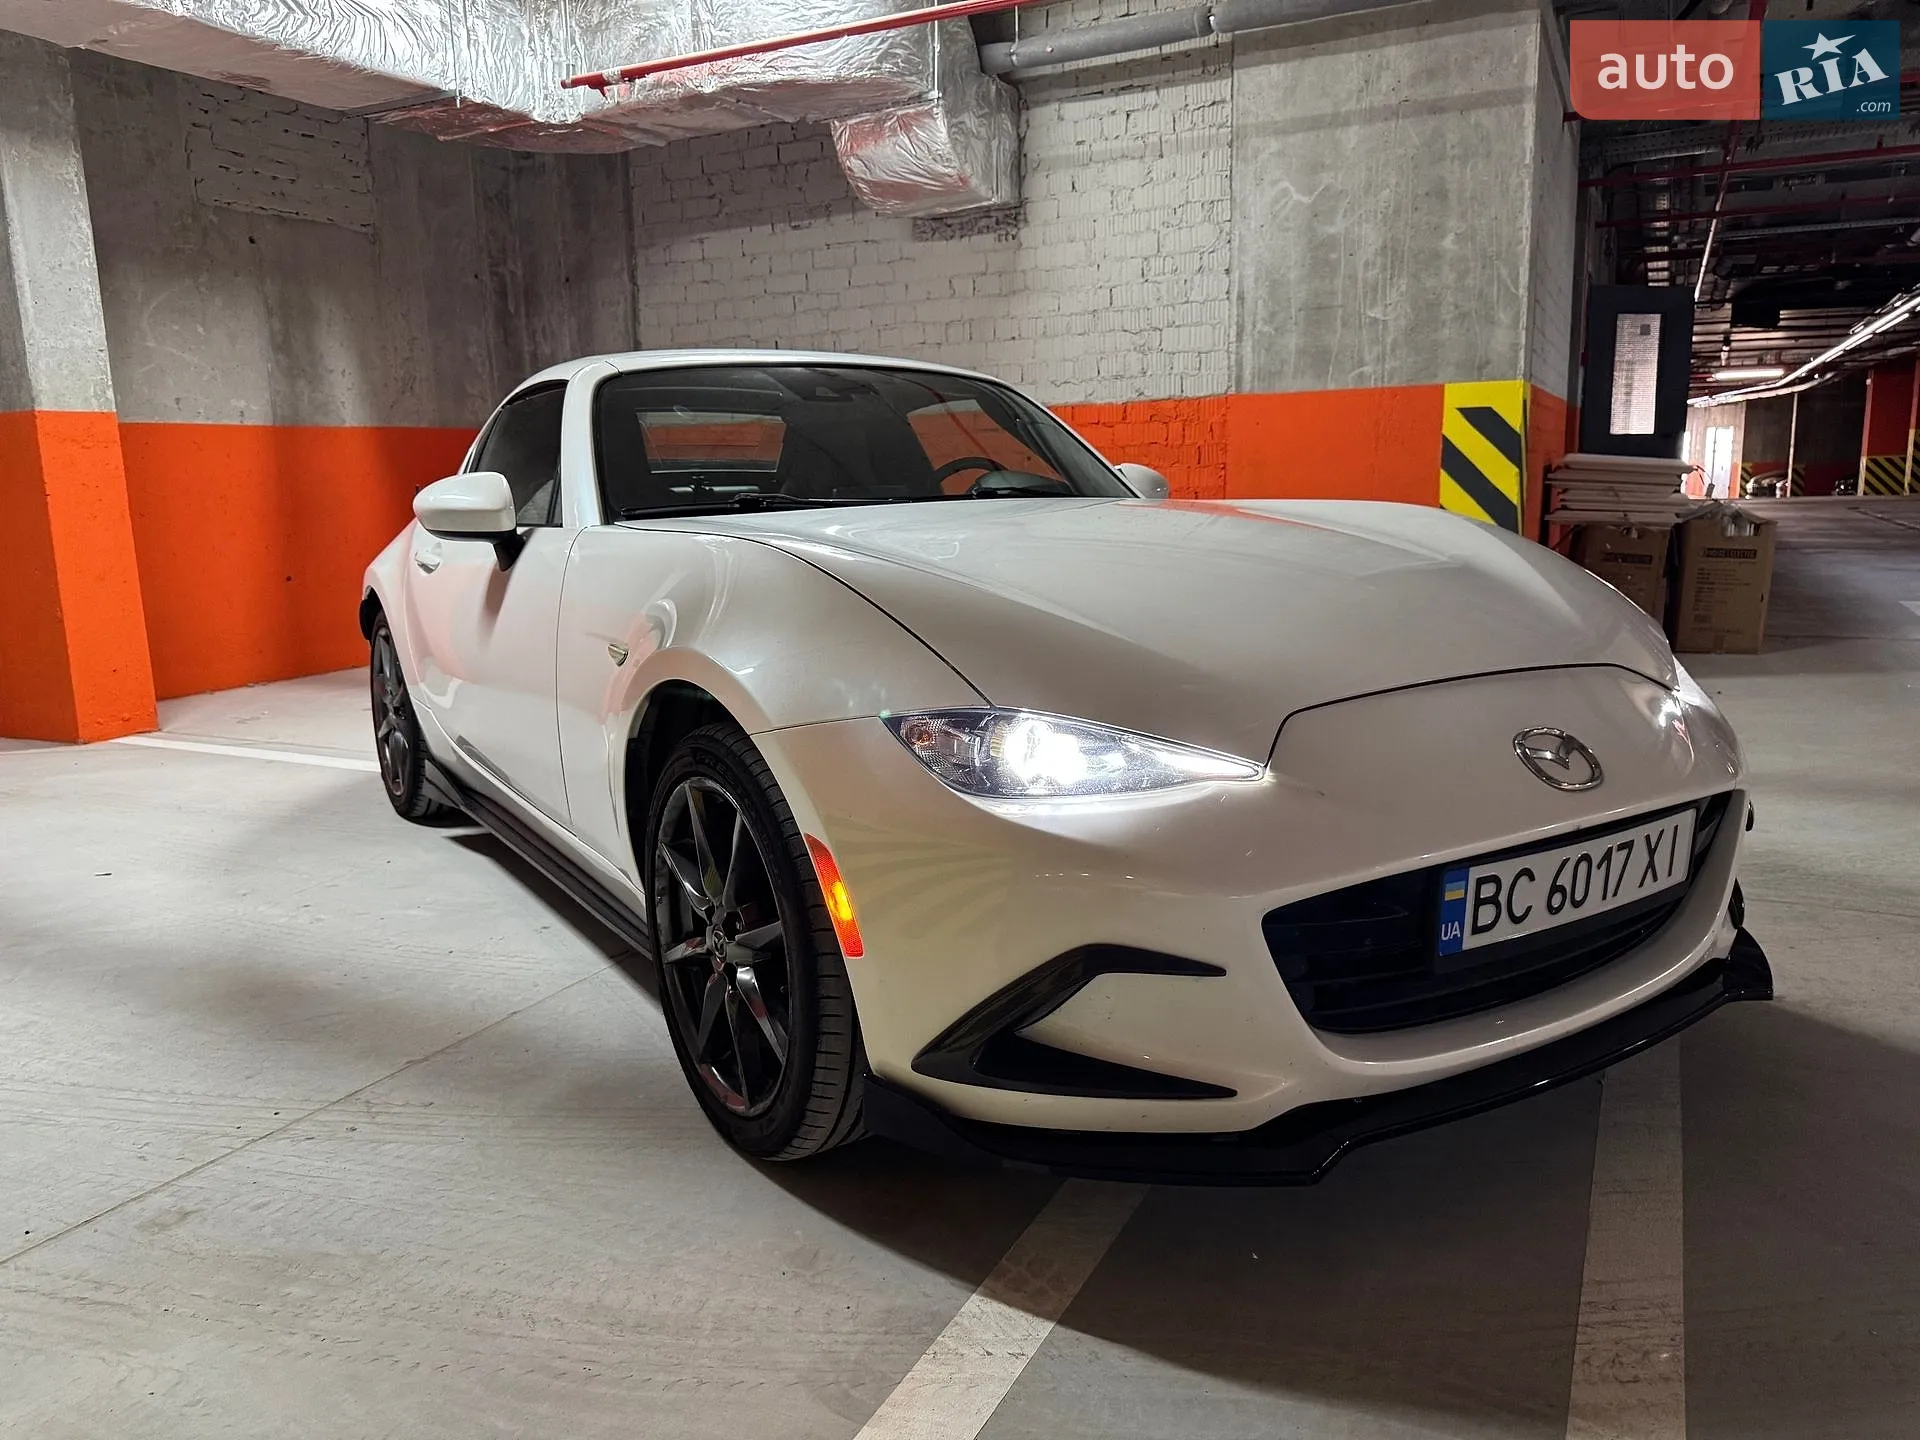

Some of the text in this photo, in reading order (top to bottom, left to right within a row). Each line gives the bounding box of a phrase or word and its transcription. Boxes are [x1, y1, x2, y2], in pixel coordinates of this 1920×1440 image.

[1471, 824, 1679, 936] BC 6017 XI
[1440, 920, 1461, 941] UA
